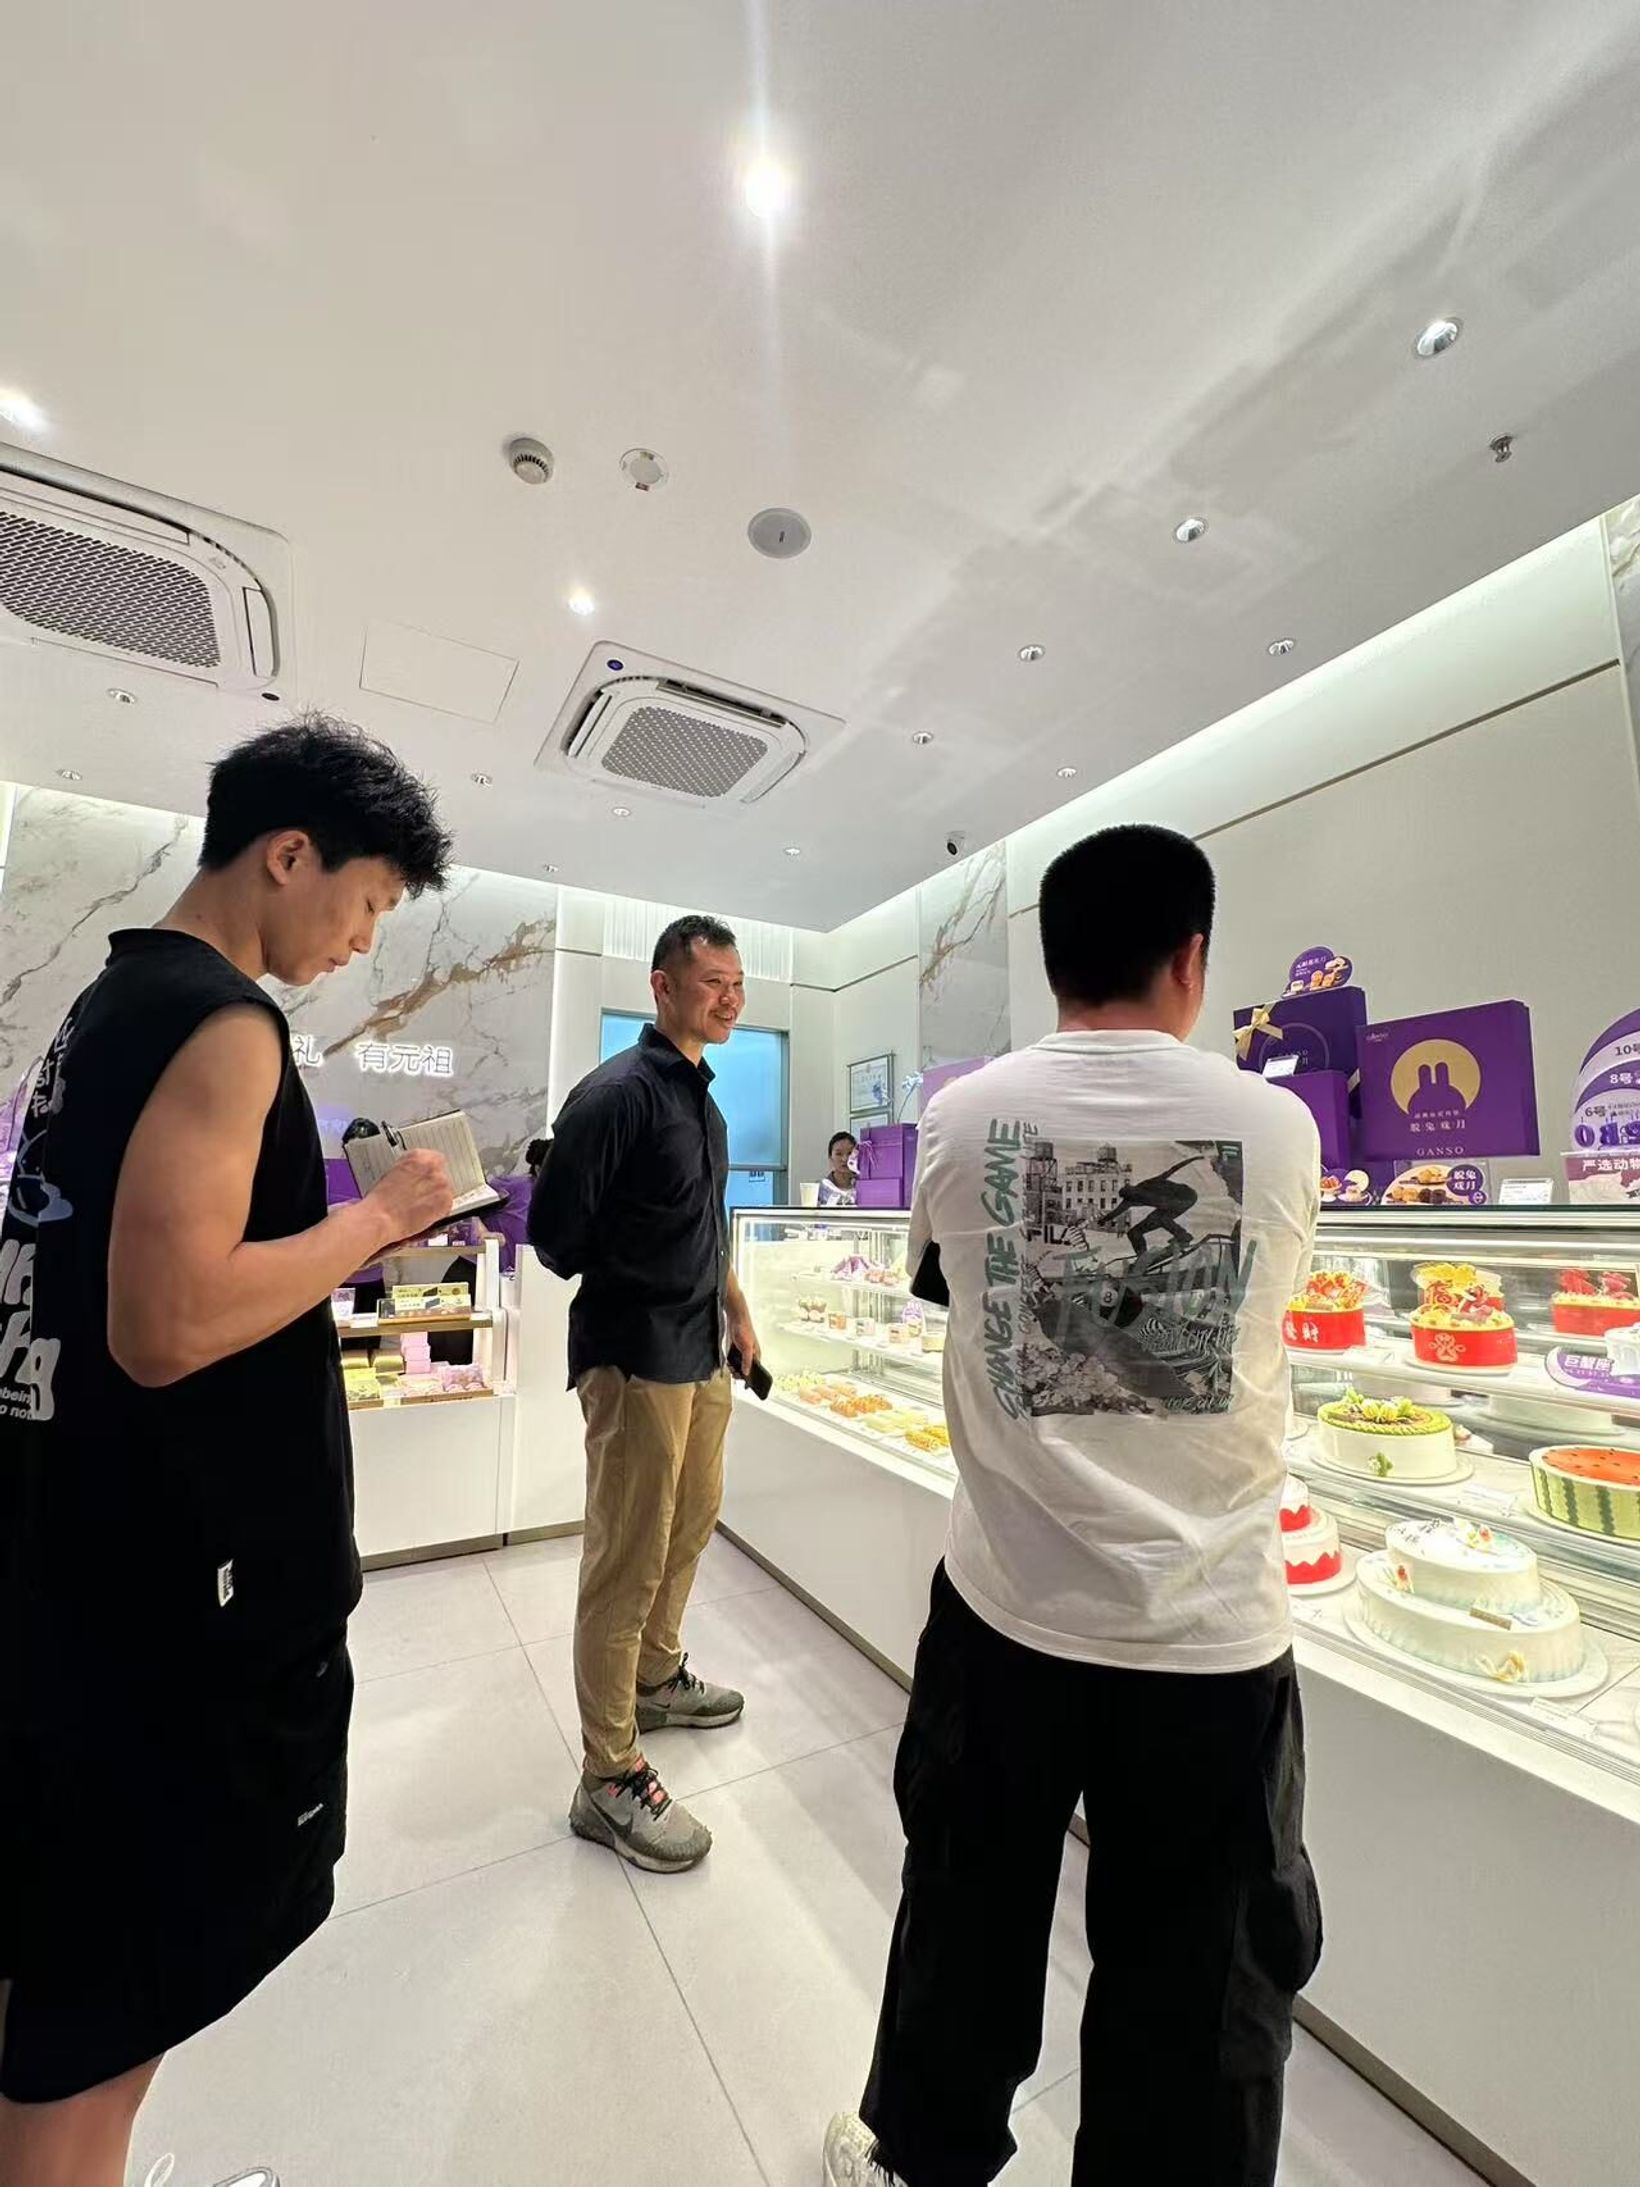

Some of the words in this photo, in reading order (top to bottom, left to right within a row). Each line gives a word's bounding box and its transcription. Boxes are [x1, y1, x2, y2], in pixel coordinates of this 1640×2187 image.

[293, 1034, 323, 1067] 礼
[357, 1041, 454, 1077] 有元祖
[981, 1118, 1021, 1227] GAME
[1416, 1144, 1465, 1157] GANSO
[984, 1232, 1020, 1286] THE
[983, 1291, 1020, 1420] CHANGE
